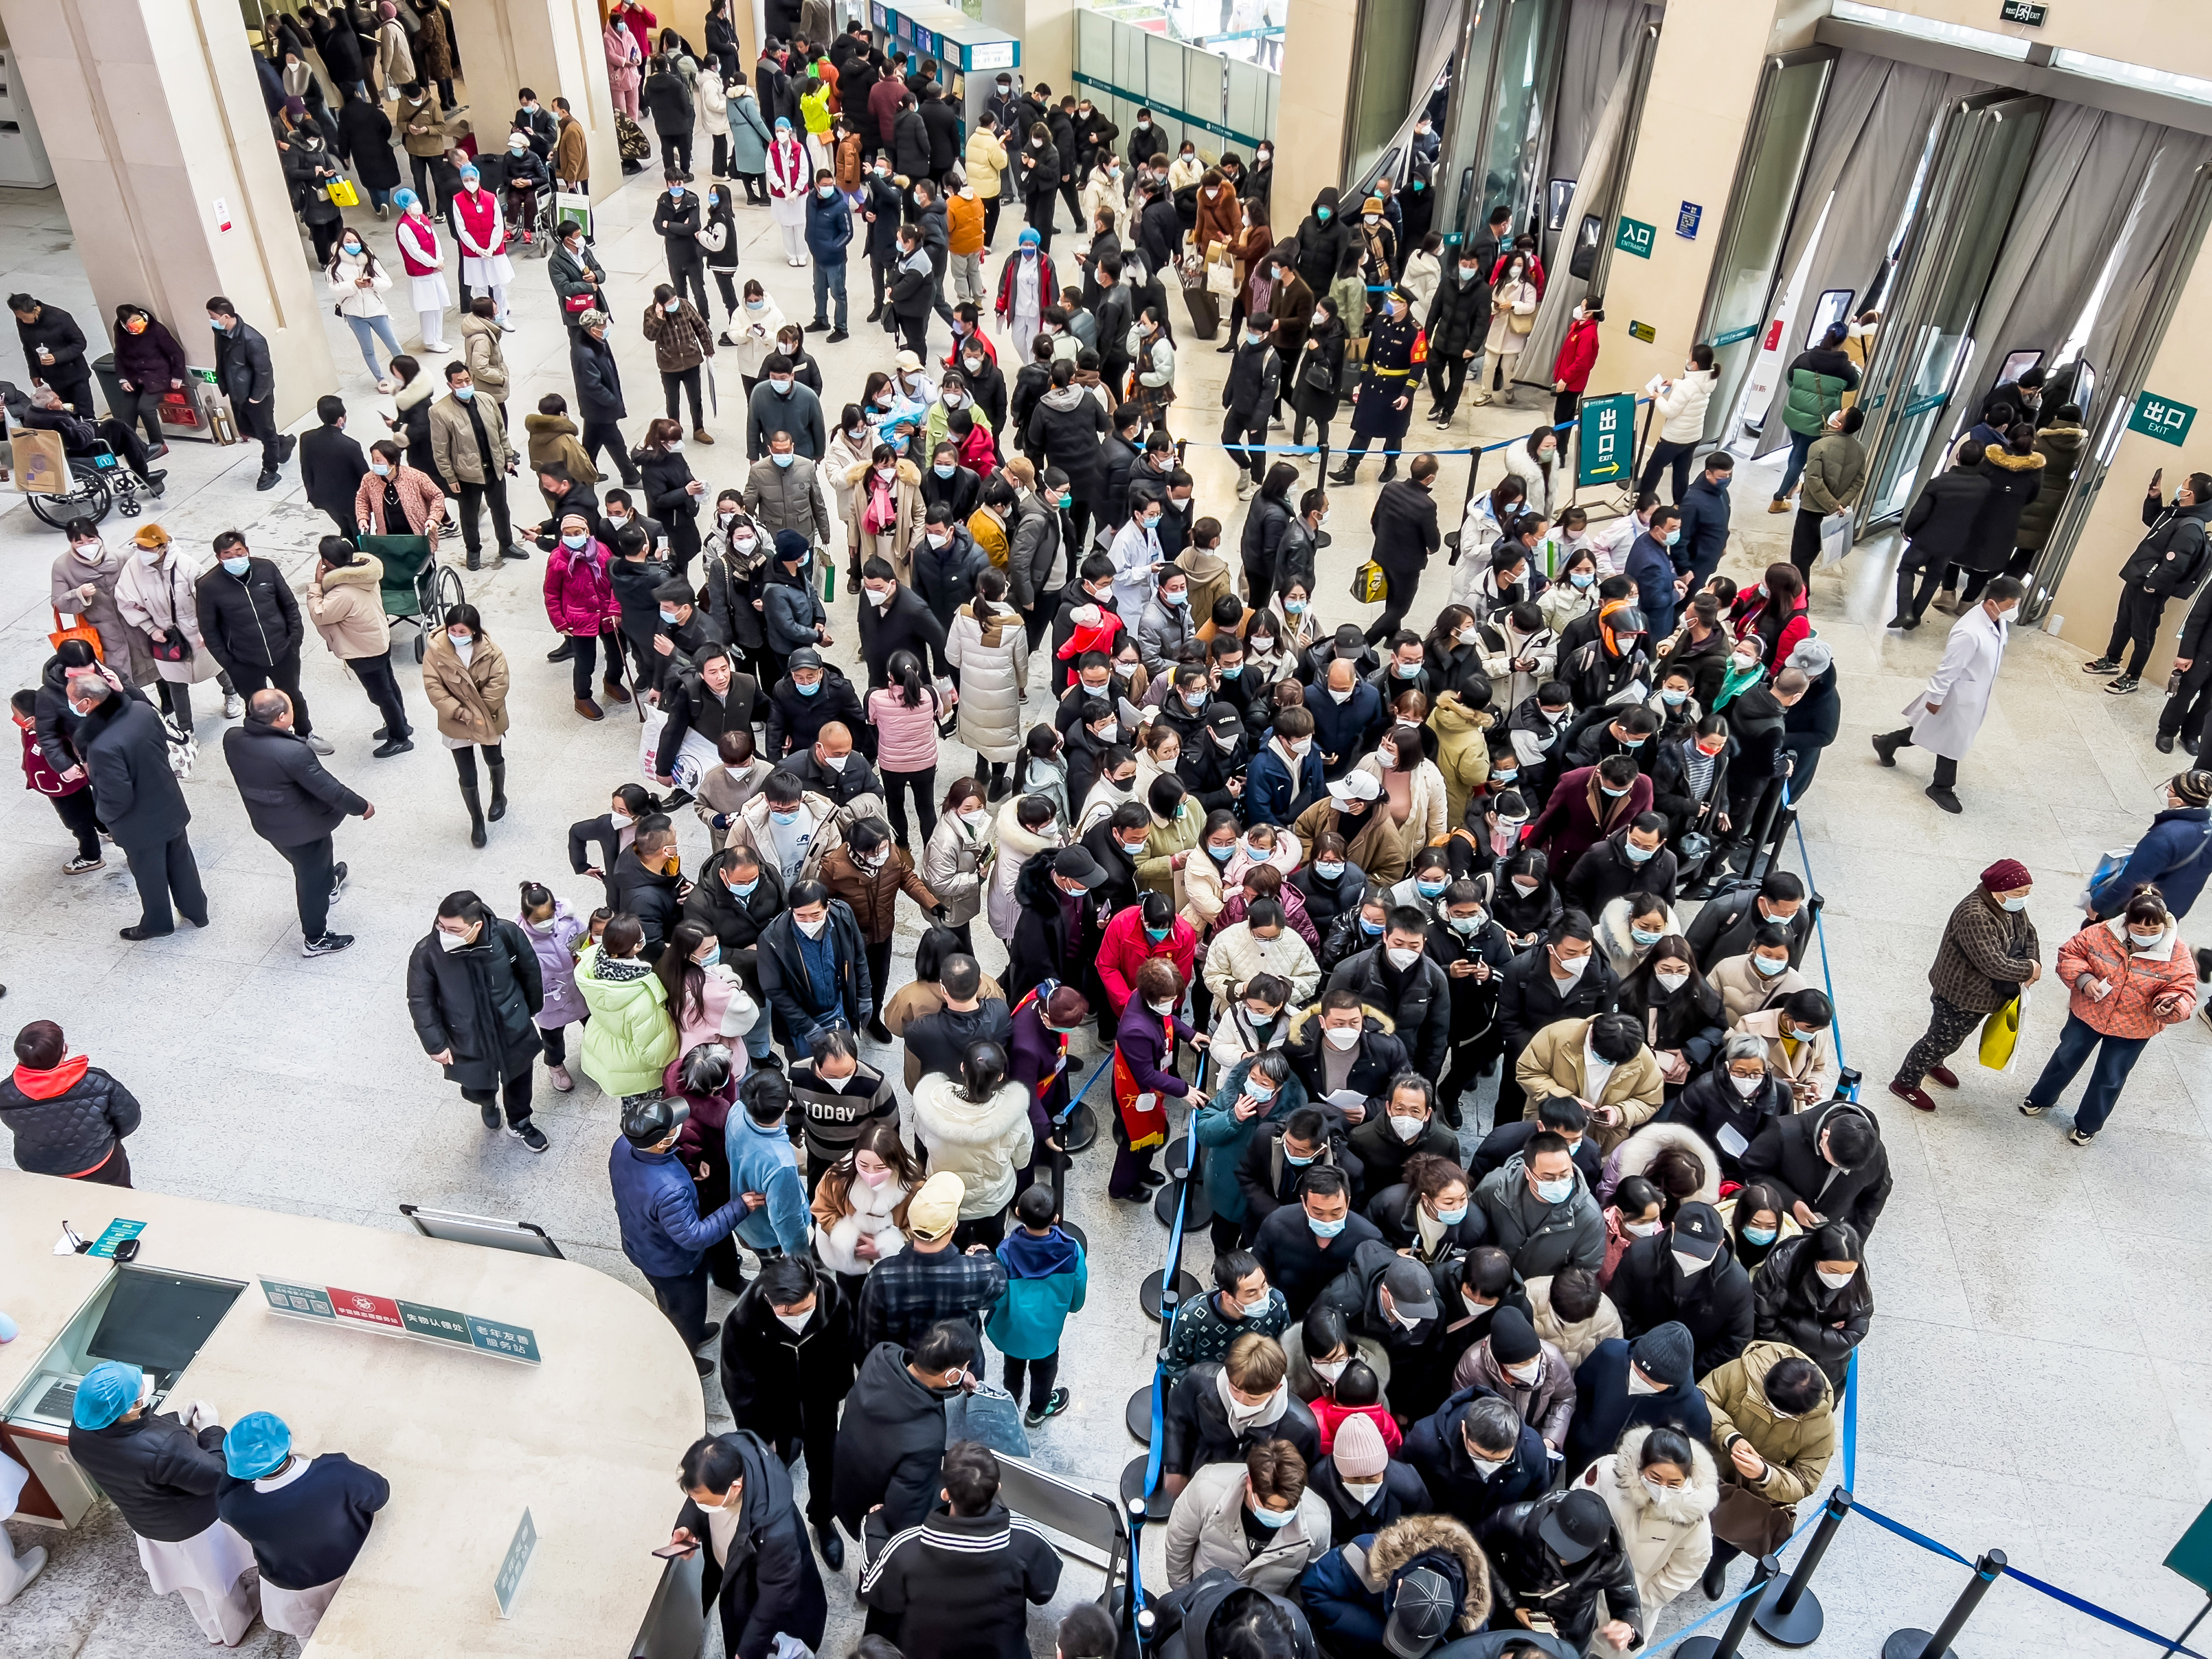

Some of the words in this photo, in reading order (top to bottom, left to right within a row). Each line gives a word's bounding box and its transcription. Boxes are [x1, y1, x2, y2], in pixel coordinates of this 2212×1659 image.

[1623, 223, 1650, 245] 入口
[1621, 239, 1647, 253] ENTRANCE
[2143, 401, 2186, 430] 出口
[1599, 408, 1617, 454] 出口
[2148, 422, 2169, 435] EXIT
[1598, 454, 1613, 462] EXIT
[1691, 1221, 1702, 1233] R
[407, 1313, 465, 1333] 失物认领处
[476, 1325, 529, 1345] 老年友善
[486, 1337, 526, 1355] 服务站
